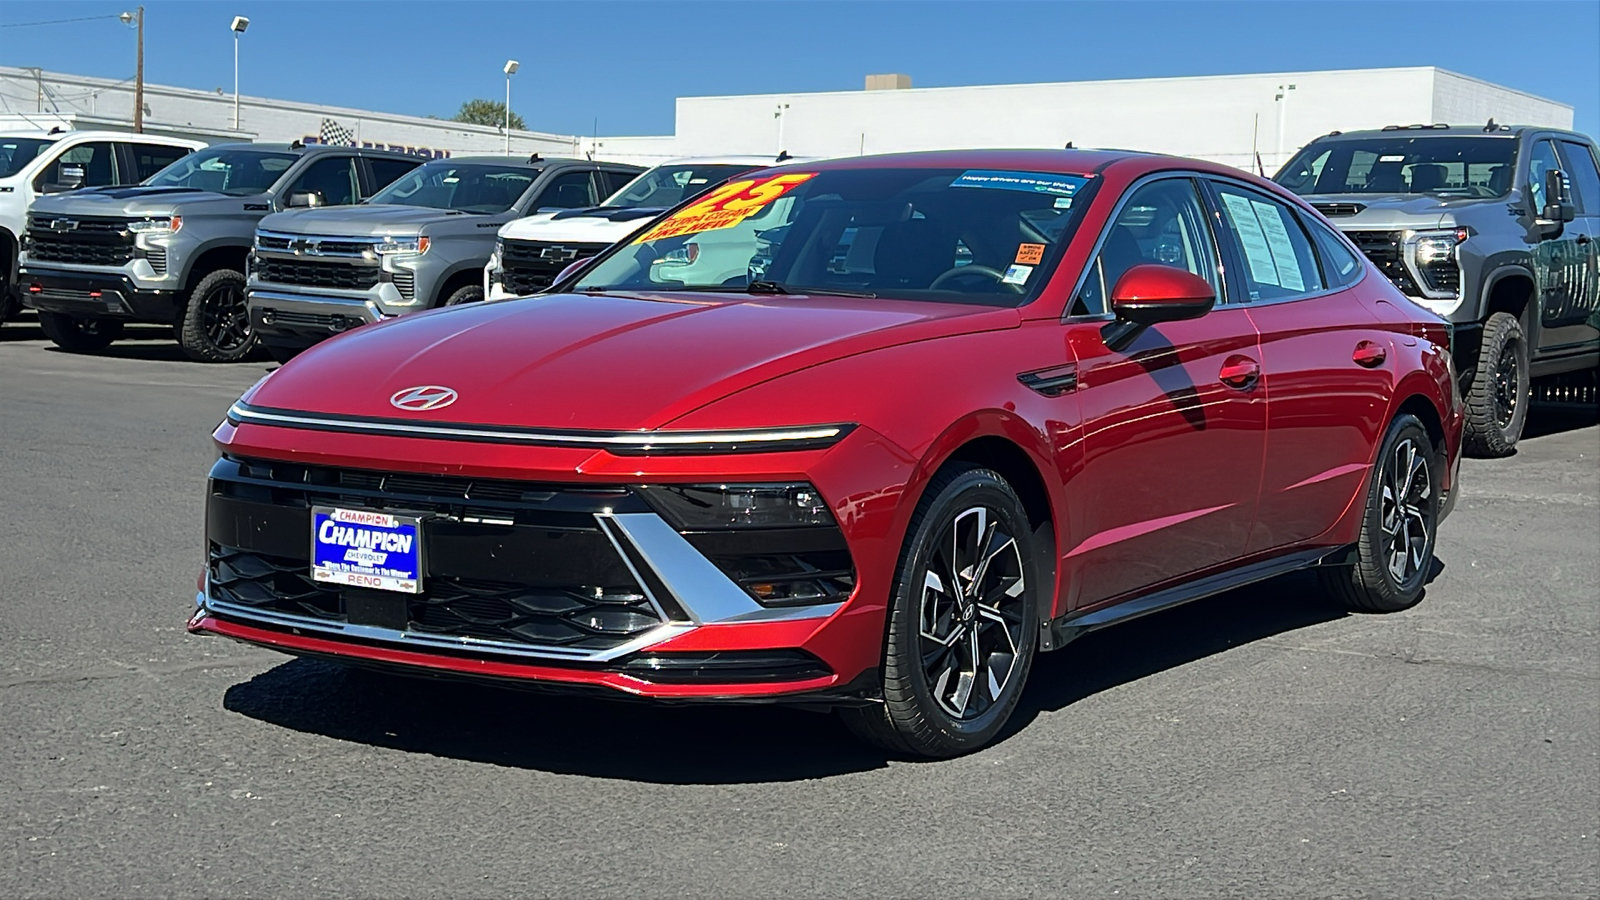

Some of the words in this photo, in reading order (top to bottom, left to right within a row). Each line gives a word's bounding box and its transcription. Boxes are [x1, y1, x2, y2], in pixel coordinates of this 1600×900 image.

[673, 174, 812, 219] 25
[640, 225, 687, 242] LIKE
[684, 217, 738, 234] NEW
[339, 511, 388, 526] CHAMPION
[319, 520, 412, 554] CHAMPION
[347, 551, 384, 561] CHEVROLET
[347, 574, 382, 587] RENO
